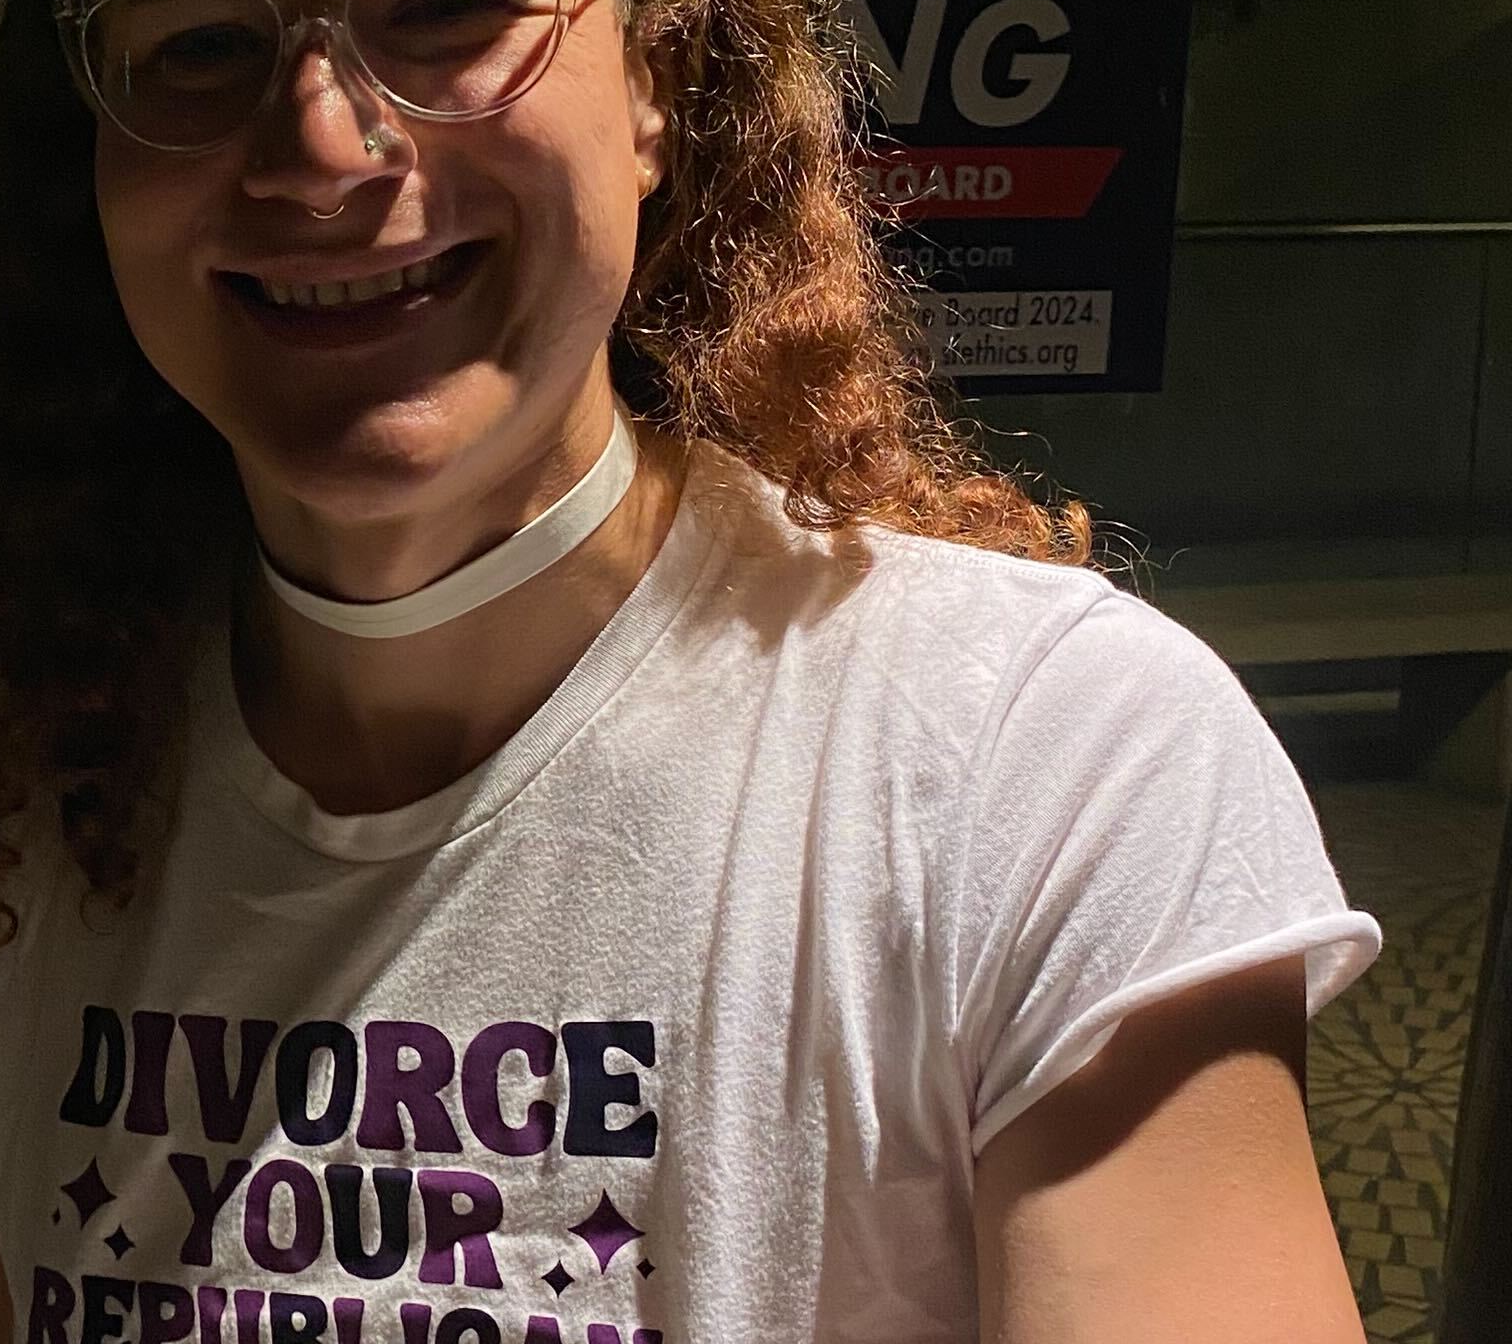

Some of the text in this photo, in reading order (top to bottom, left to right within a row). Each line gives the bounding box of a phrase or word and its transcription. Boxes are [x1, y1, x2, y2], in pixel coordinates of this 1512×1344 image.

[945, 293, 1021, 327] Board
[1029, 295, 1100, 327] 2024.
[59, 1004, 657, 1158] DIVORCE
[168, 1153, 504, 1290] YOUR
